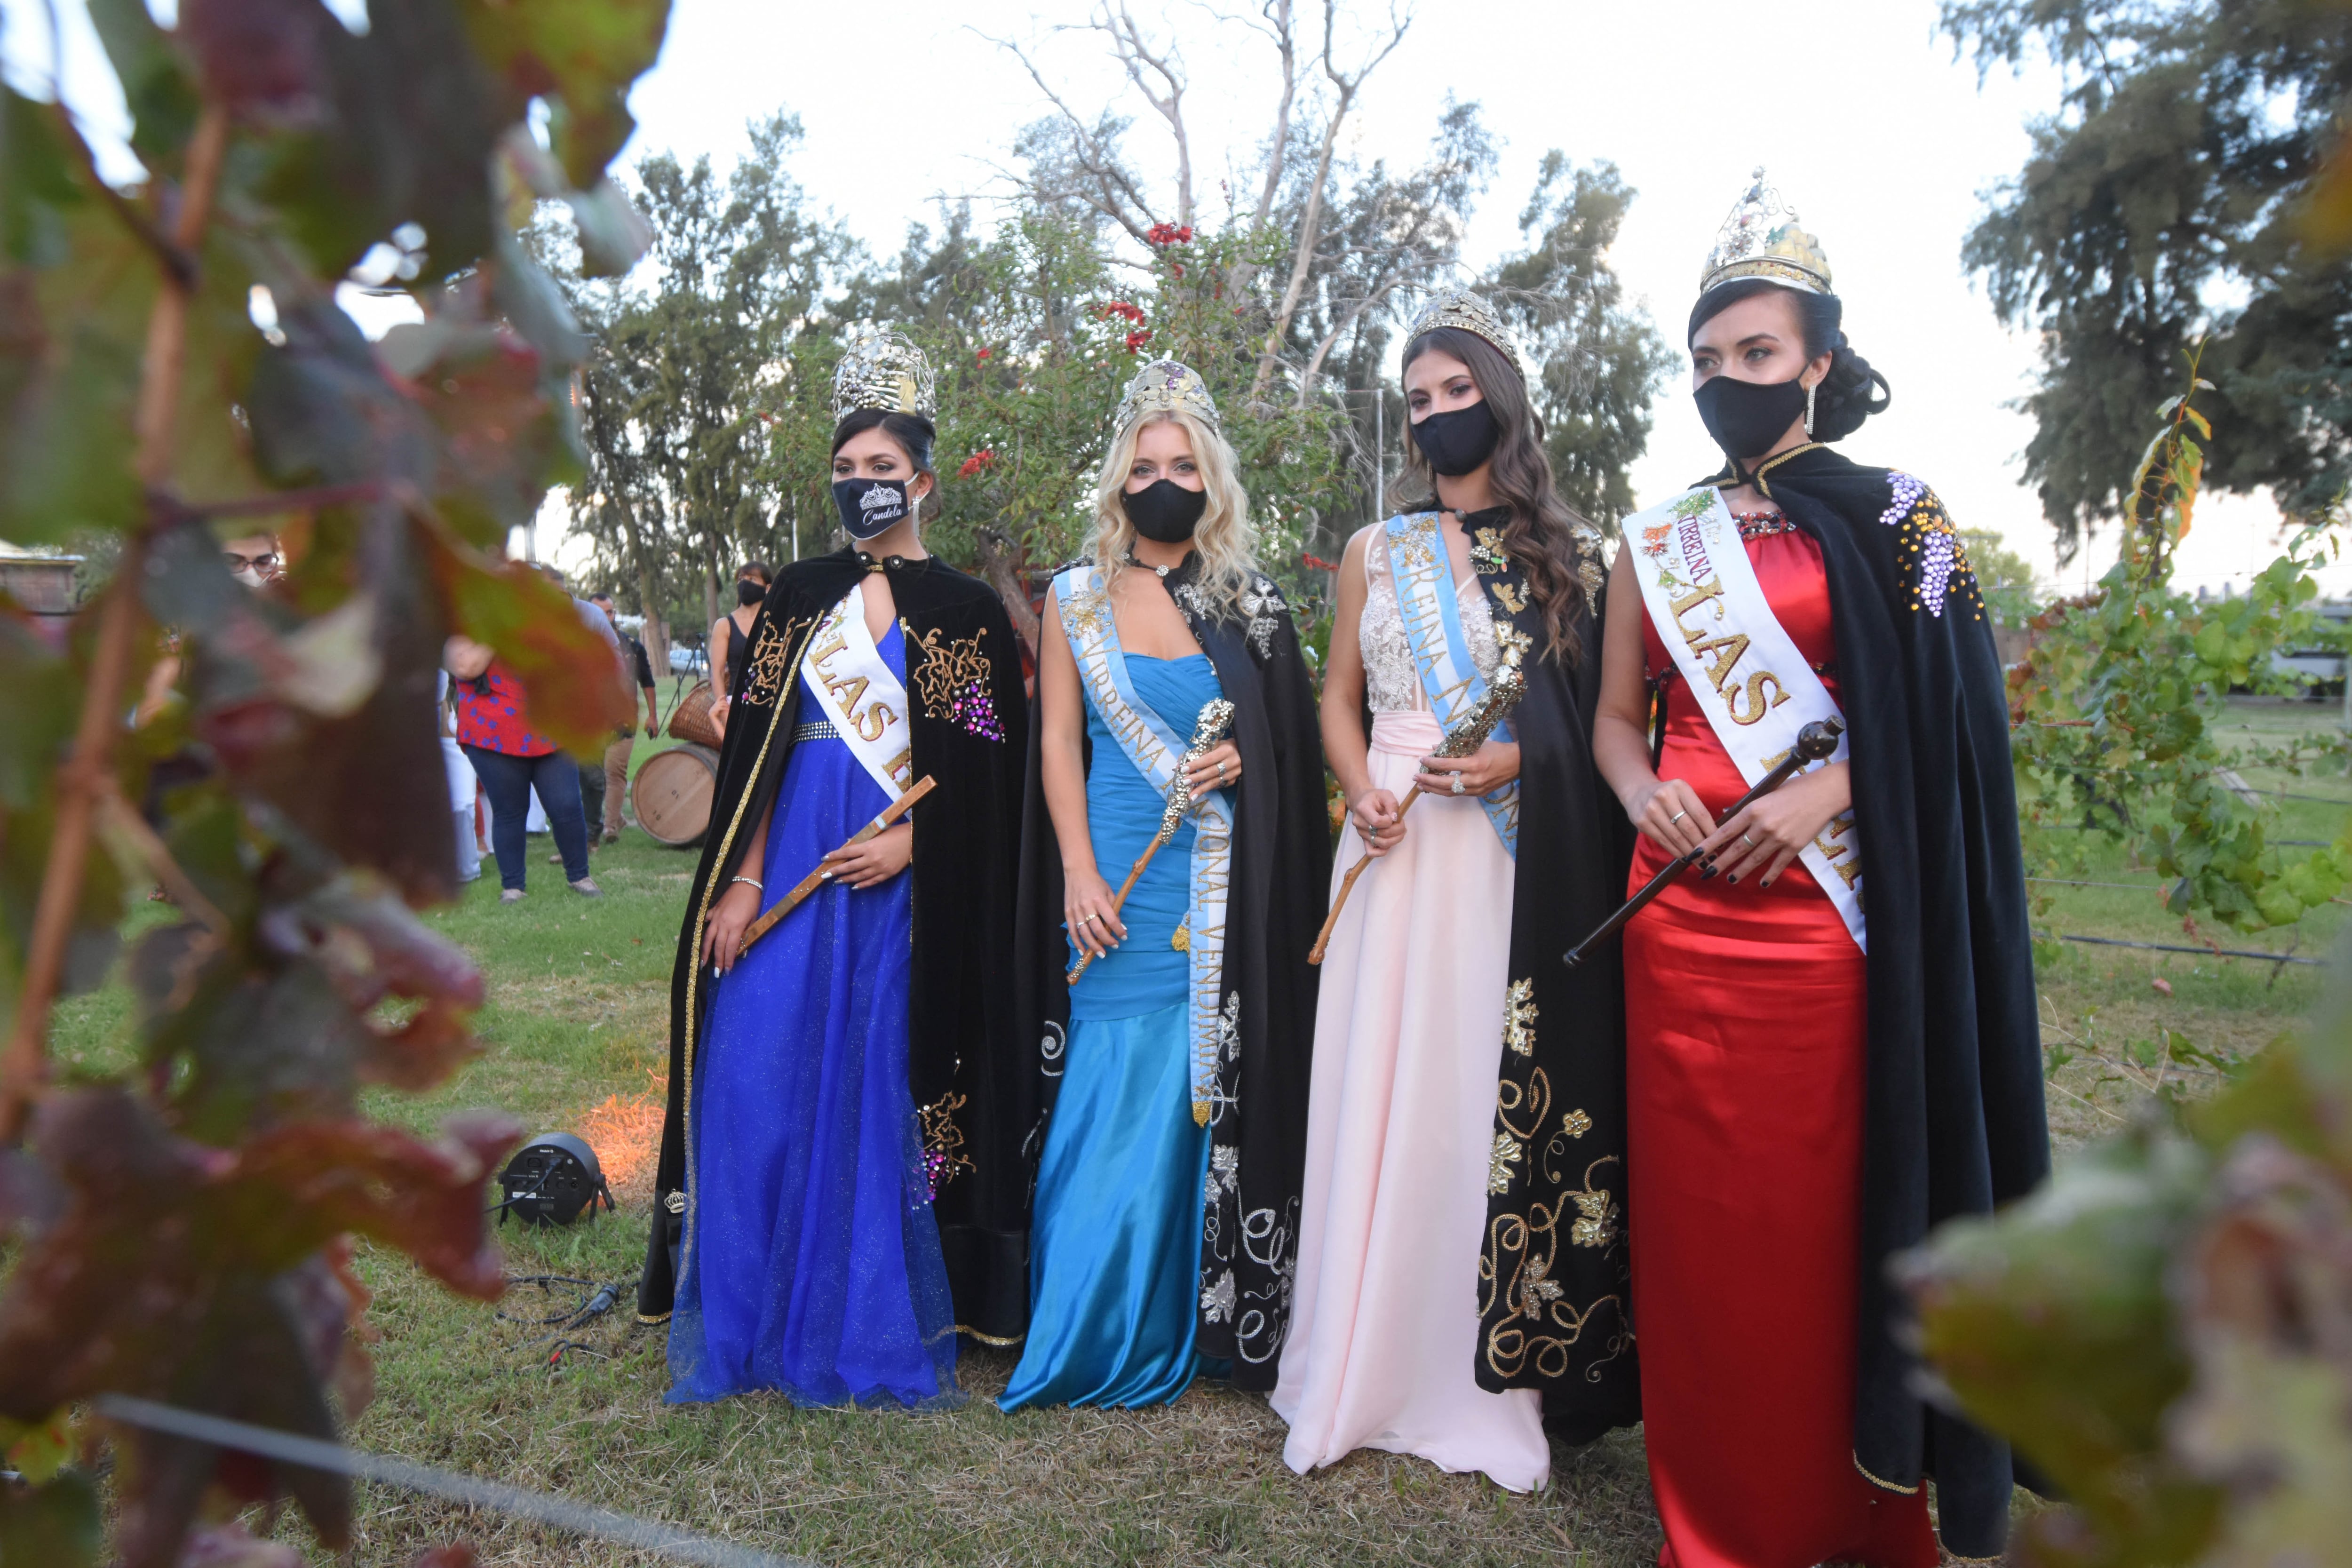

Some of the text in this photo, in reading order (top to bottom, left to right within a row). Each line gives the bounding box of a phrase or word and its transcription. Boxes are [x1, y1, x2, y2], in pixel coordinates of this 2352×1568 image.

[863, 504, 902, 525] Candela
[1677, 513, 1712, 585] VIRREINA
[1397, 560, 1448, 678] REINA
[1669, 574, 1791, 726] LAS
[808, 631, 899, 742] LAS
[1077, 629, 1167, 776] VIRREINA
[1159, 780, 1230, 912] ACIONAL
